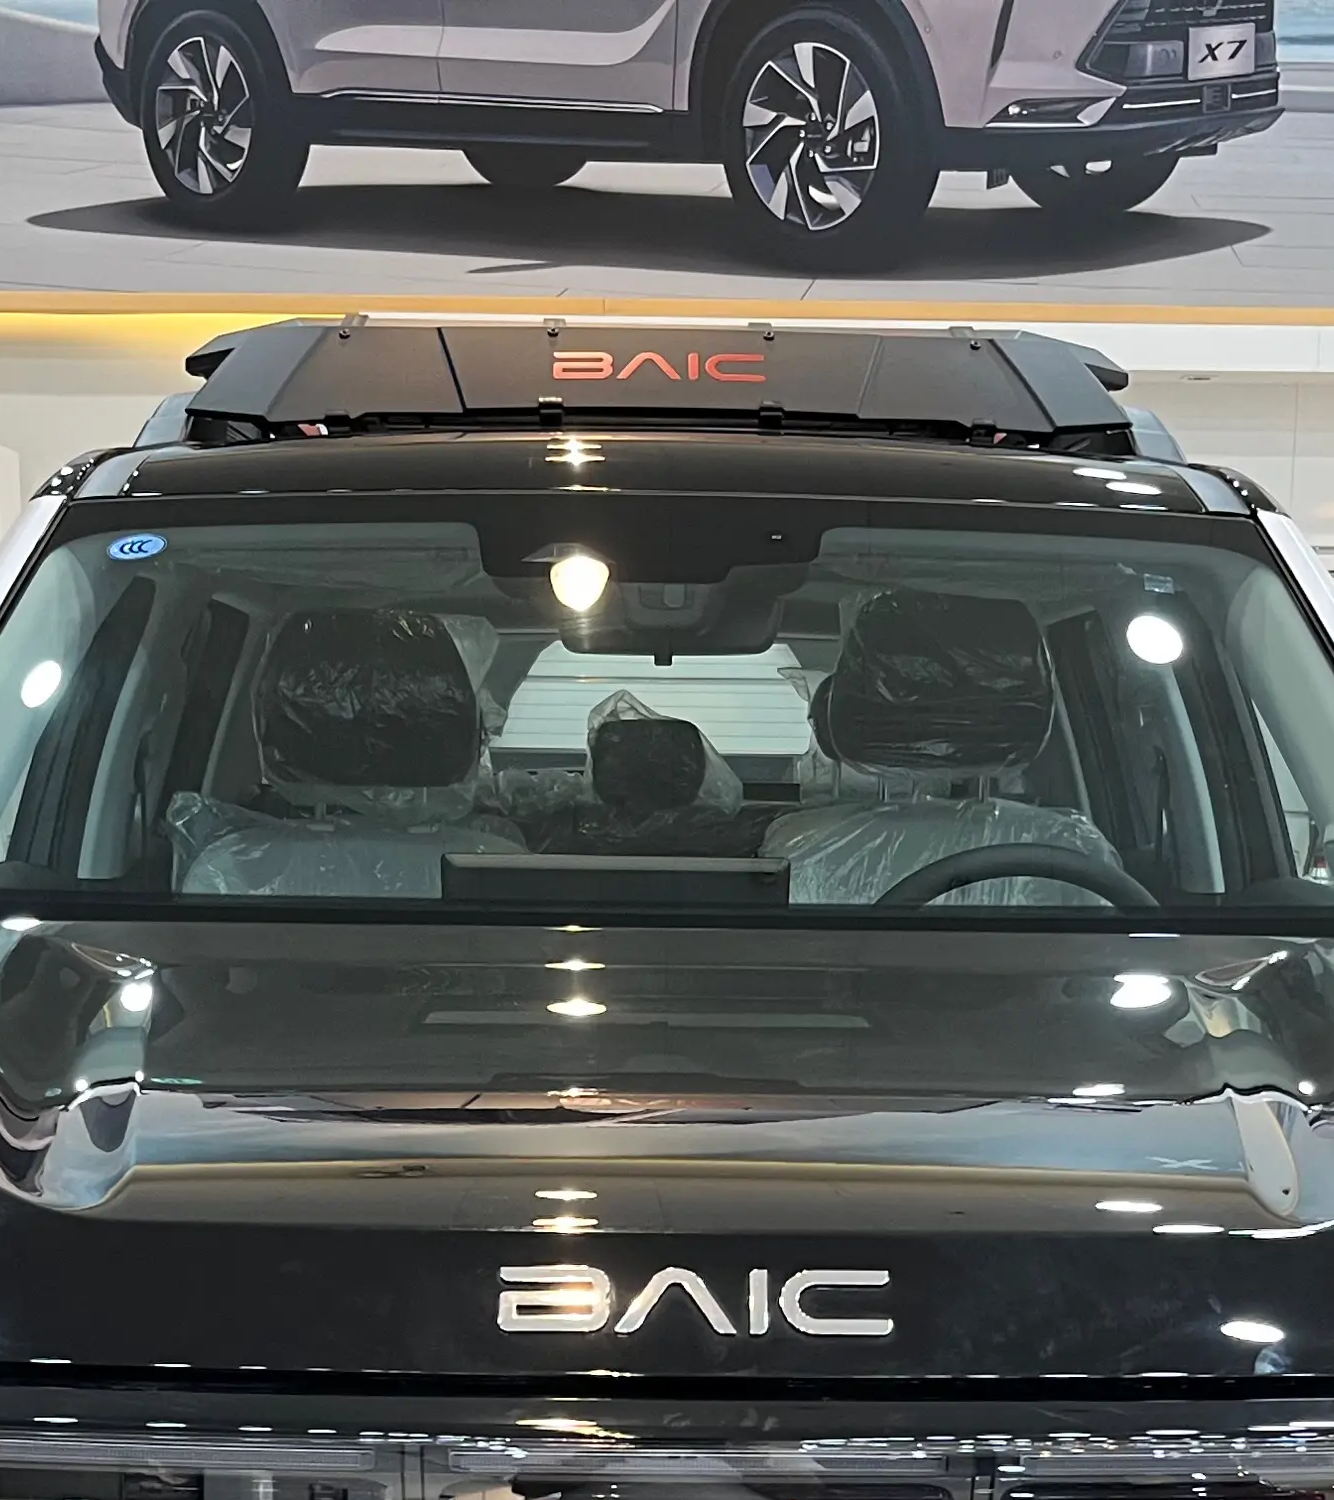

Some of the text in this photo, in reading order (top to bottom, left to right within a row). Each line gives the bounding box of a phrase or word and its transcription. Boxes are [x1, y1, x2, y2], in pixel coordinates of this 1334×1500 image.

[1199, 39, 1248, 64] X7
[552, 351, 767, 384] BAIC
[497, 1264, 894, 1337] BAIC
